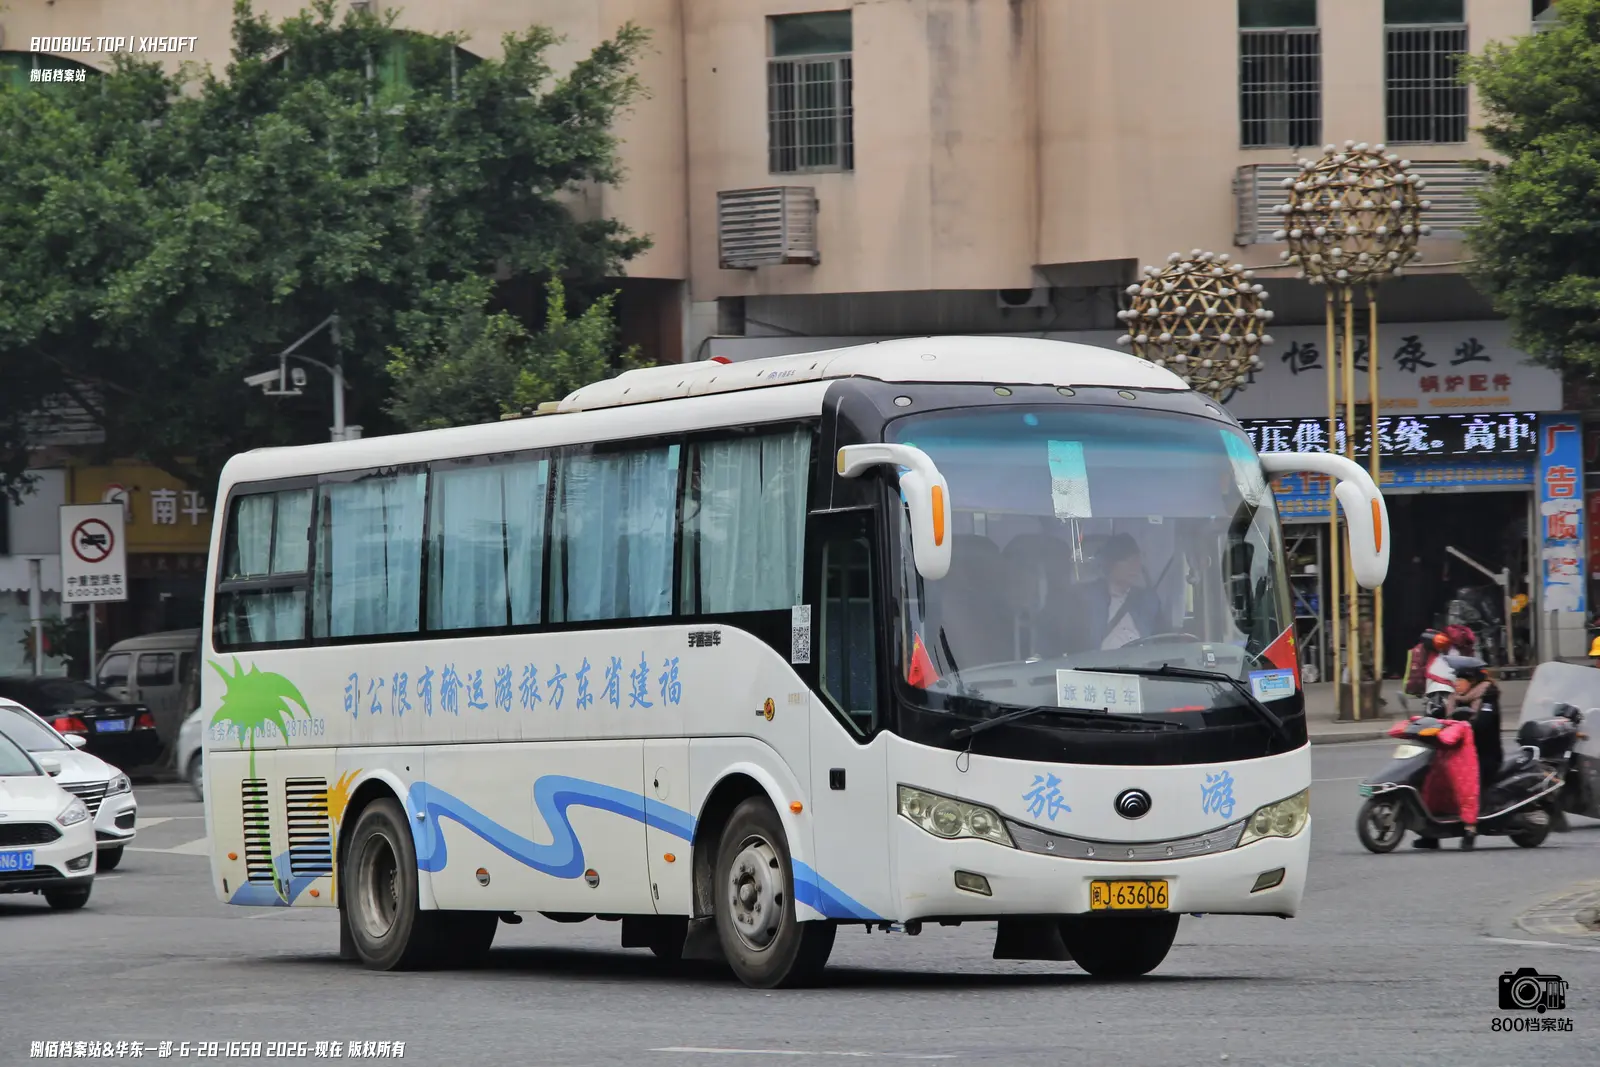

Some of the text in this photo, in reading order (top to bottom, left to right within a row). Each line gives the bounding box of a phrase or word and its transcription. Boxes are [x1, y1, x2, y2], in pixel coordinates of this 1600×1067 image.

[1419, 373, 1511, 392] 锅炉配件
[151, 488, 208, 526] 南平
[1064, 683, 1137, 706] 旅游包车
